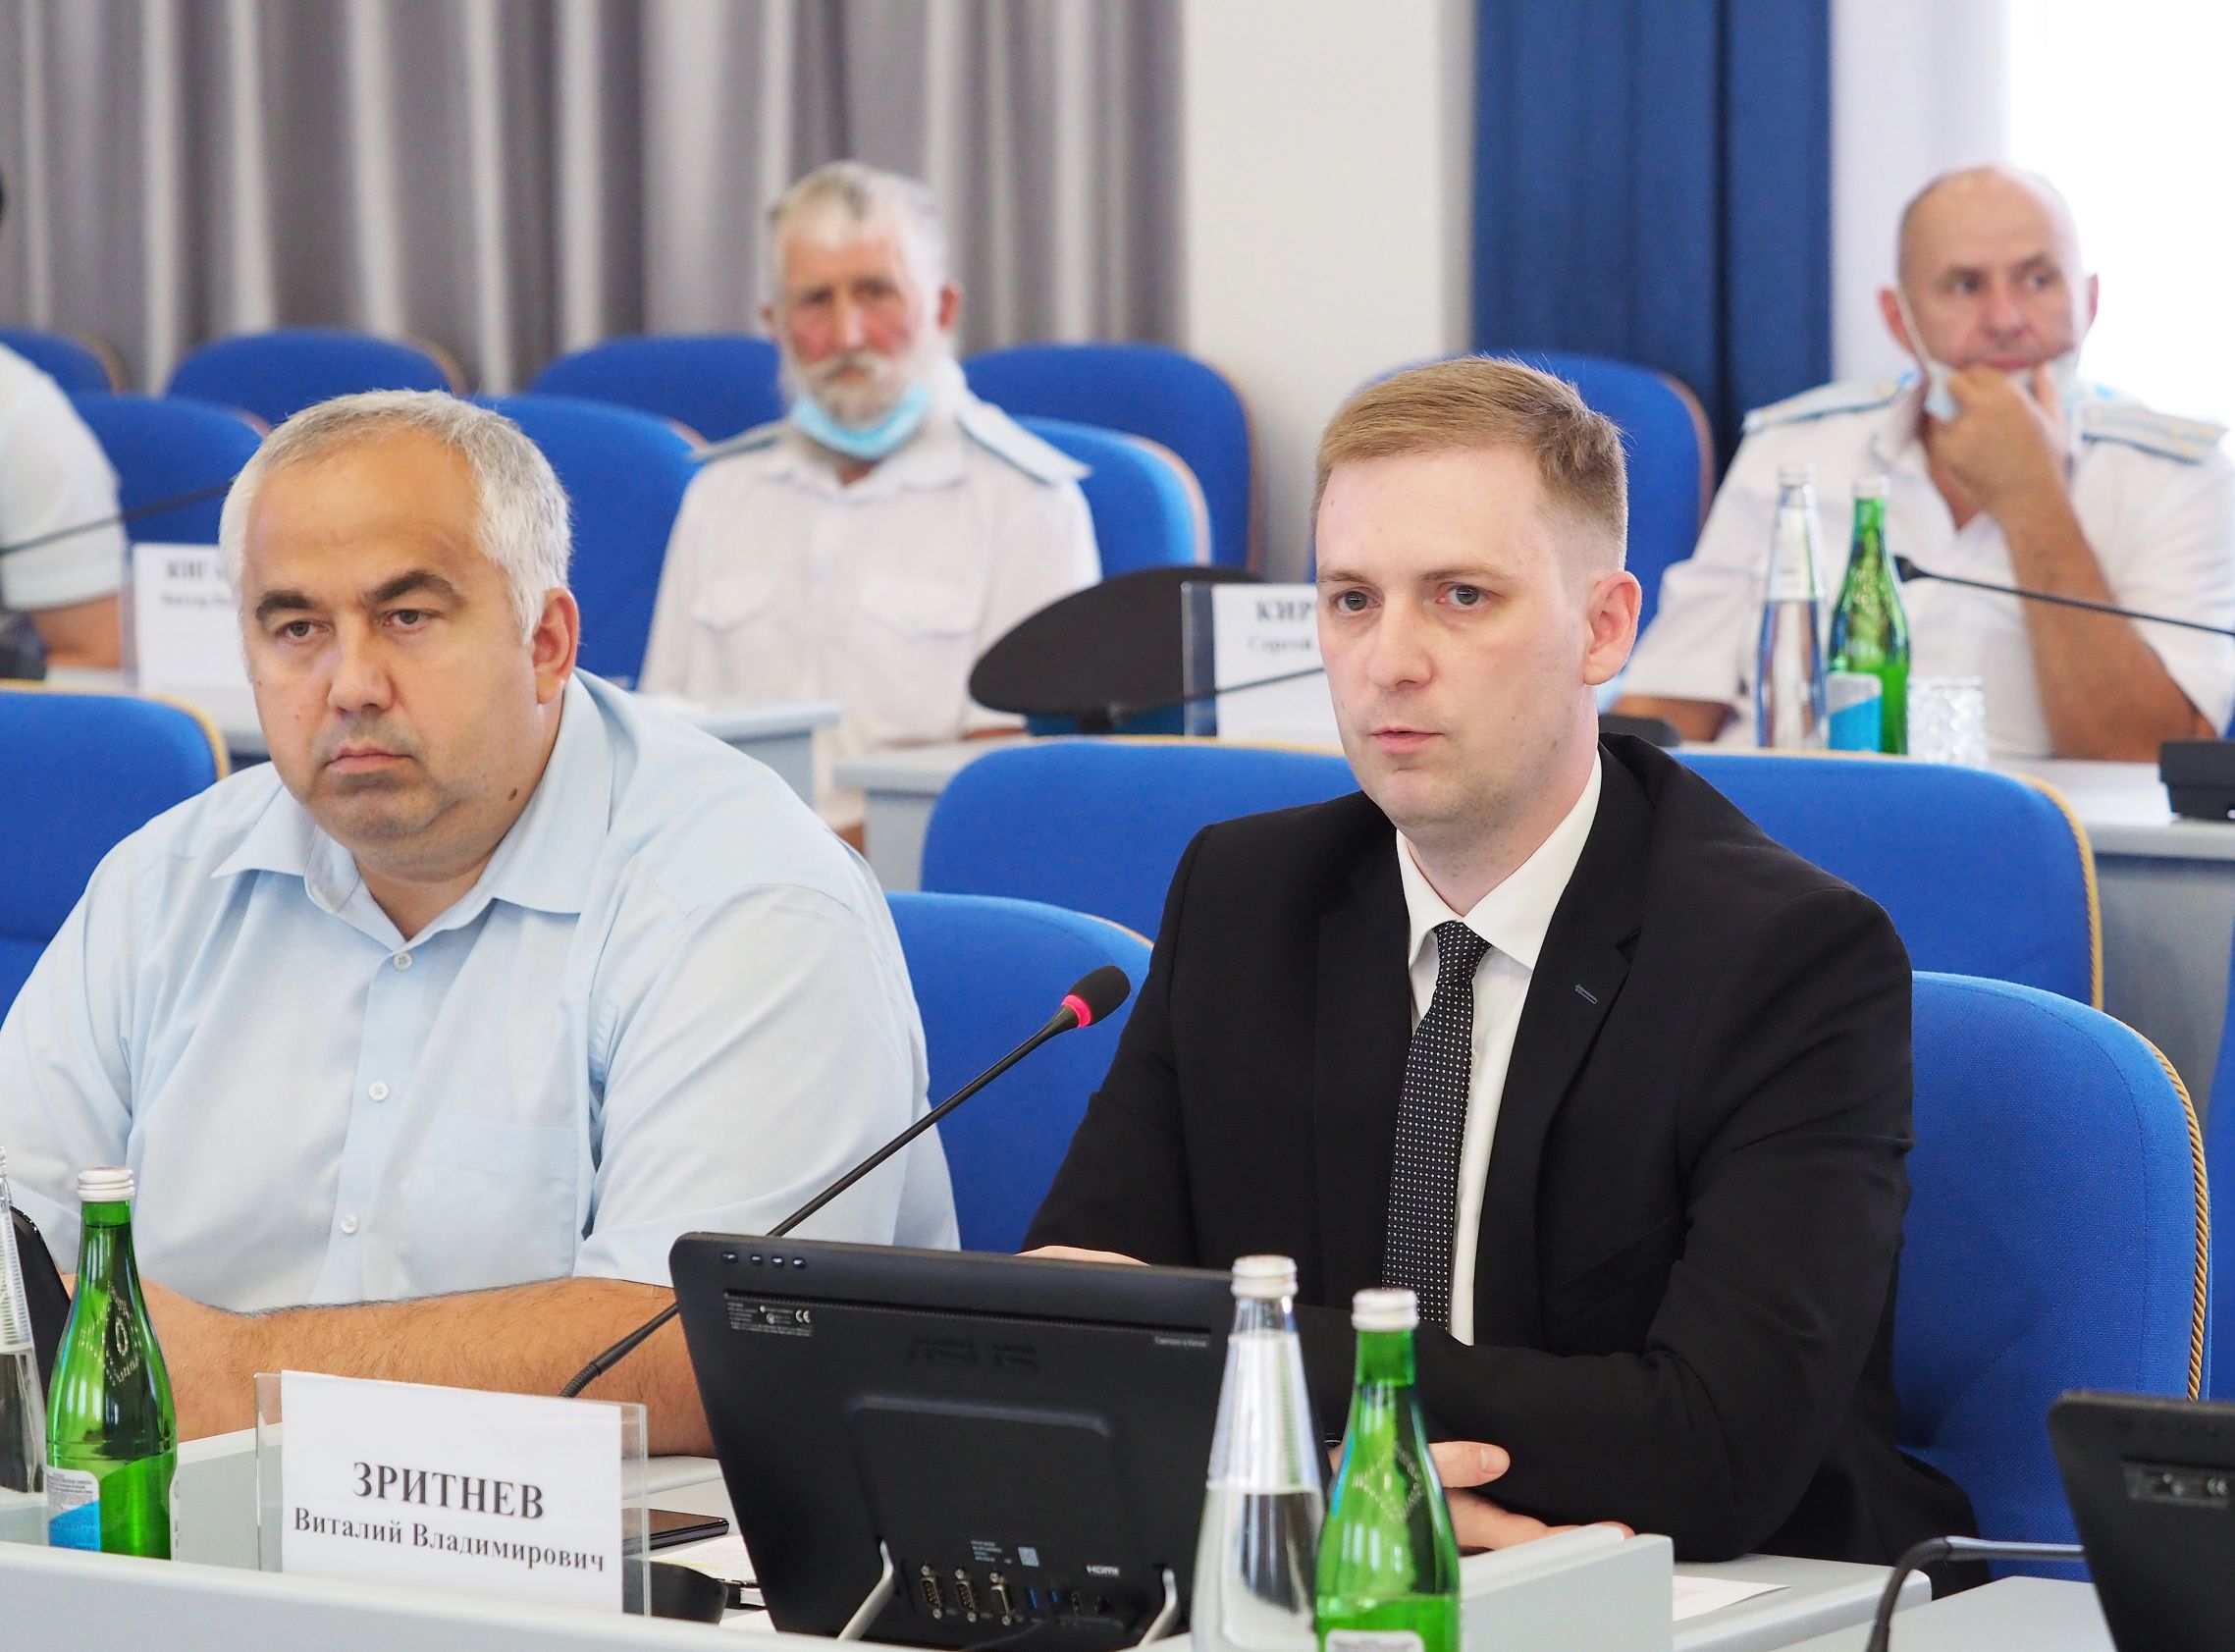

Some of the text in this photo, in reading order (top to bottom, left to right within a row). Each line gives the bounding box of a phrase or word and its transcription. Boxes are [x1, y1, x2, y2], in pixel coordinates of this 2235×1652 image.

[1256, 600, 1316, 620] КИР
[352, 1461, 544, 1519] ЗРИТНЕВ
[293, 1506, 605, 1572] Виталий Владимирович
